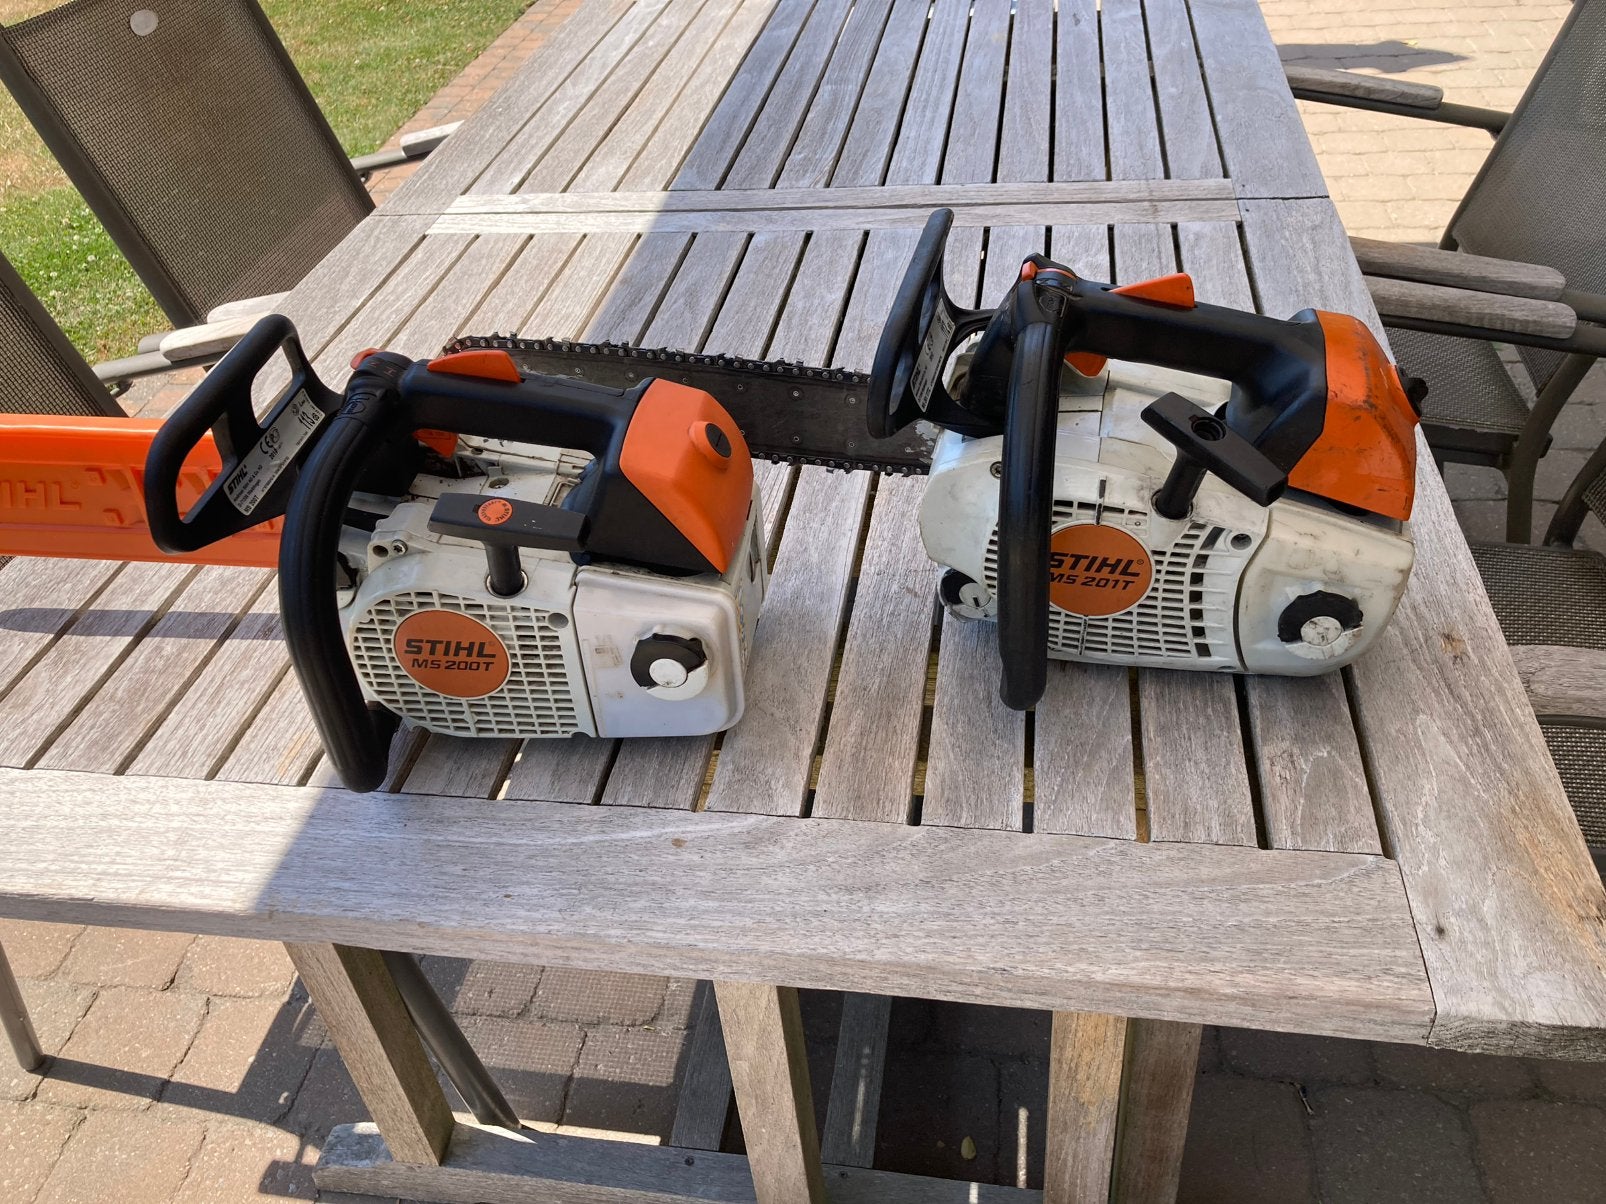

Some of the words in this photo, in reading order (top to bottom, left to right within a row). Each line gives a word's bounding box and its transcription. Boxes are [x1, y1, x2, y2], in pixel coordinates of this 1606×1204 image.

[227, 466, 248, 495] STIHL
[0, 479, 82, 509] IHL
[1050, 552, 1141, 577] STIHL
[1081, 576, 1136, 590] 201T
[404, 638, 497, 659] STIHL
[411, 658, 442, 669] MS
[444, 660, 495, 671] 200T
